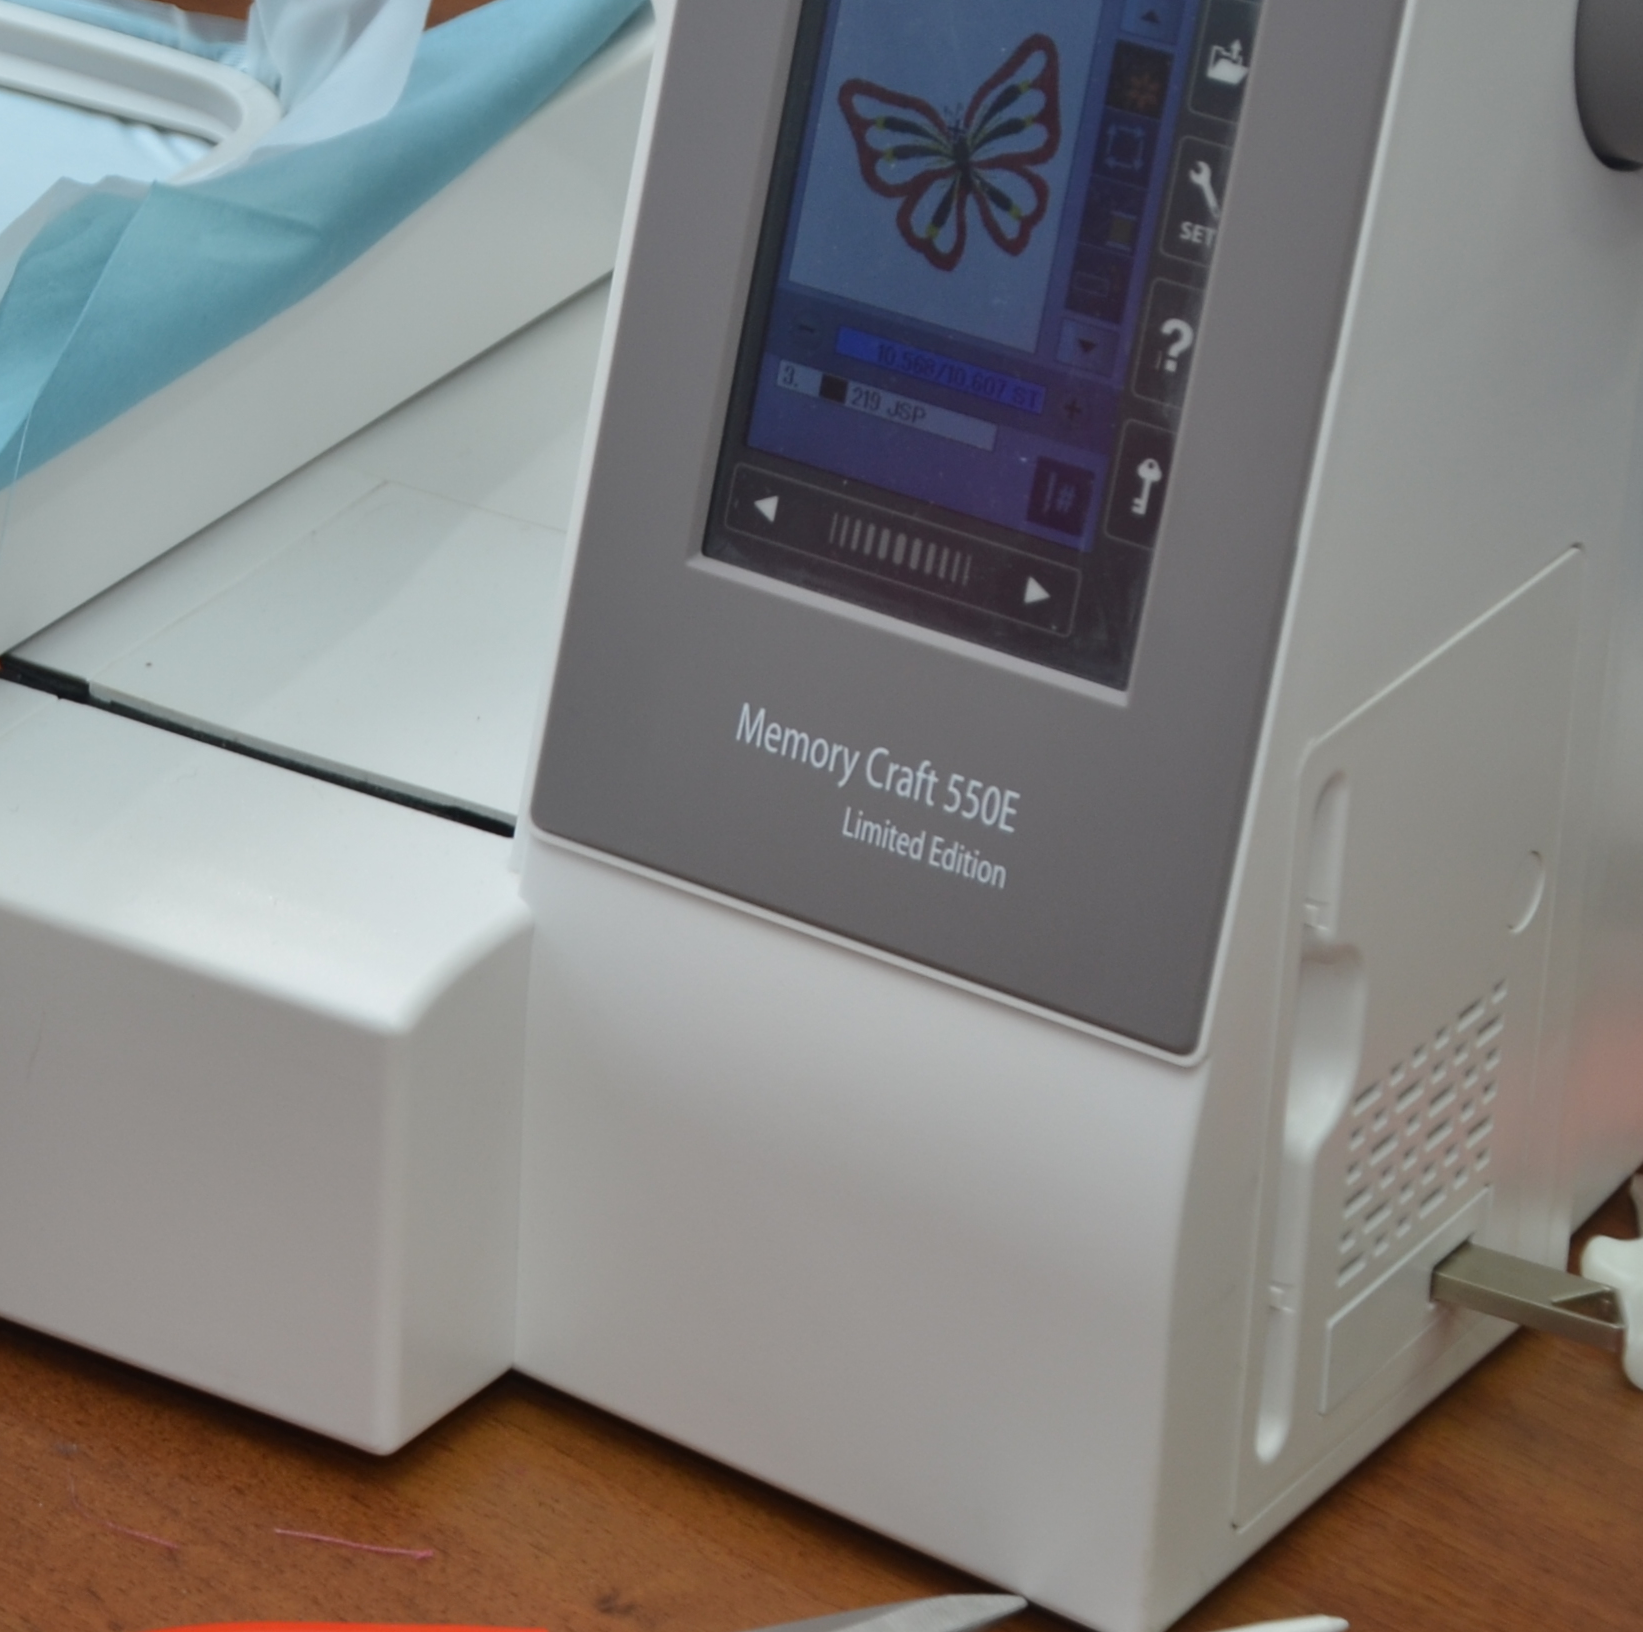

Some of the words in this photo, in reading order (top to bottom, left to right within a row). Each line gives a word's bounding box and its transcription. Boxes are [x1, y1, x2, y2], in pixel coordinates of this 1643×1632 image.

[1179, 220, 1217, 249] SET
[850, 386, 882, 411] 219
[886, 399, 927, 424] JSP
[1011, 386, 1044, 410] ST
[735, 702, 861, 787] Memory
[865, 747, 939, 808] Craft
[942, 773, 1020, 834] 550E
[841, 806, 927, 861] Limited
[928, 835, 1007, 889] Edition
